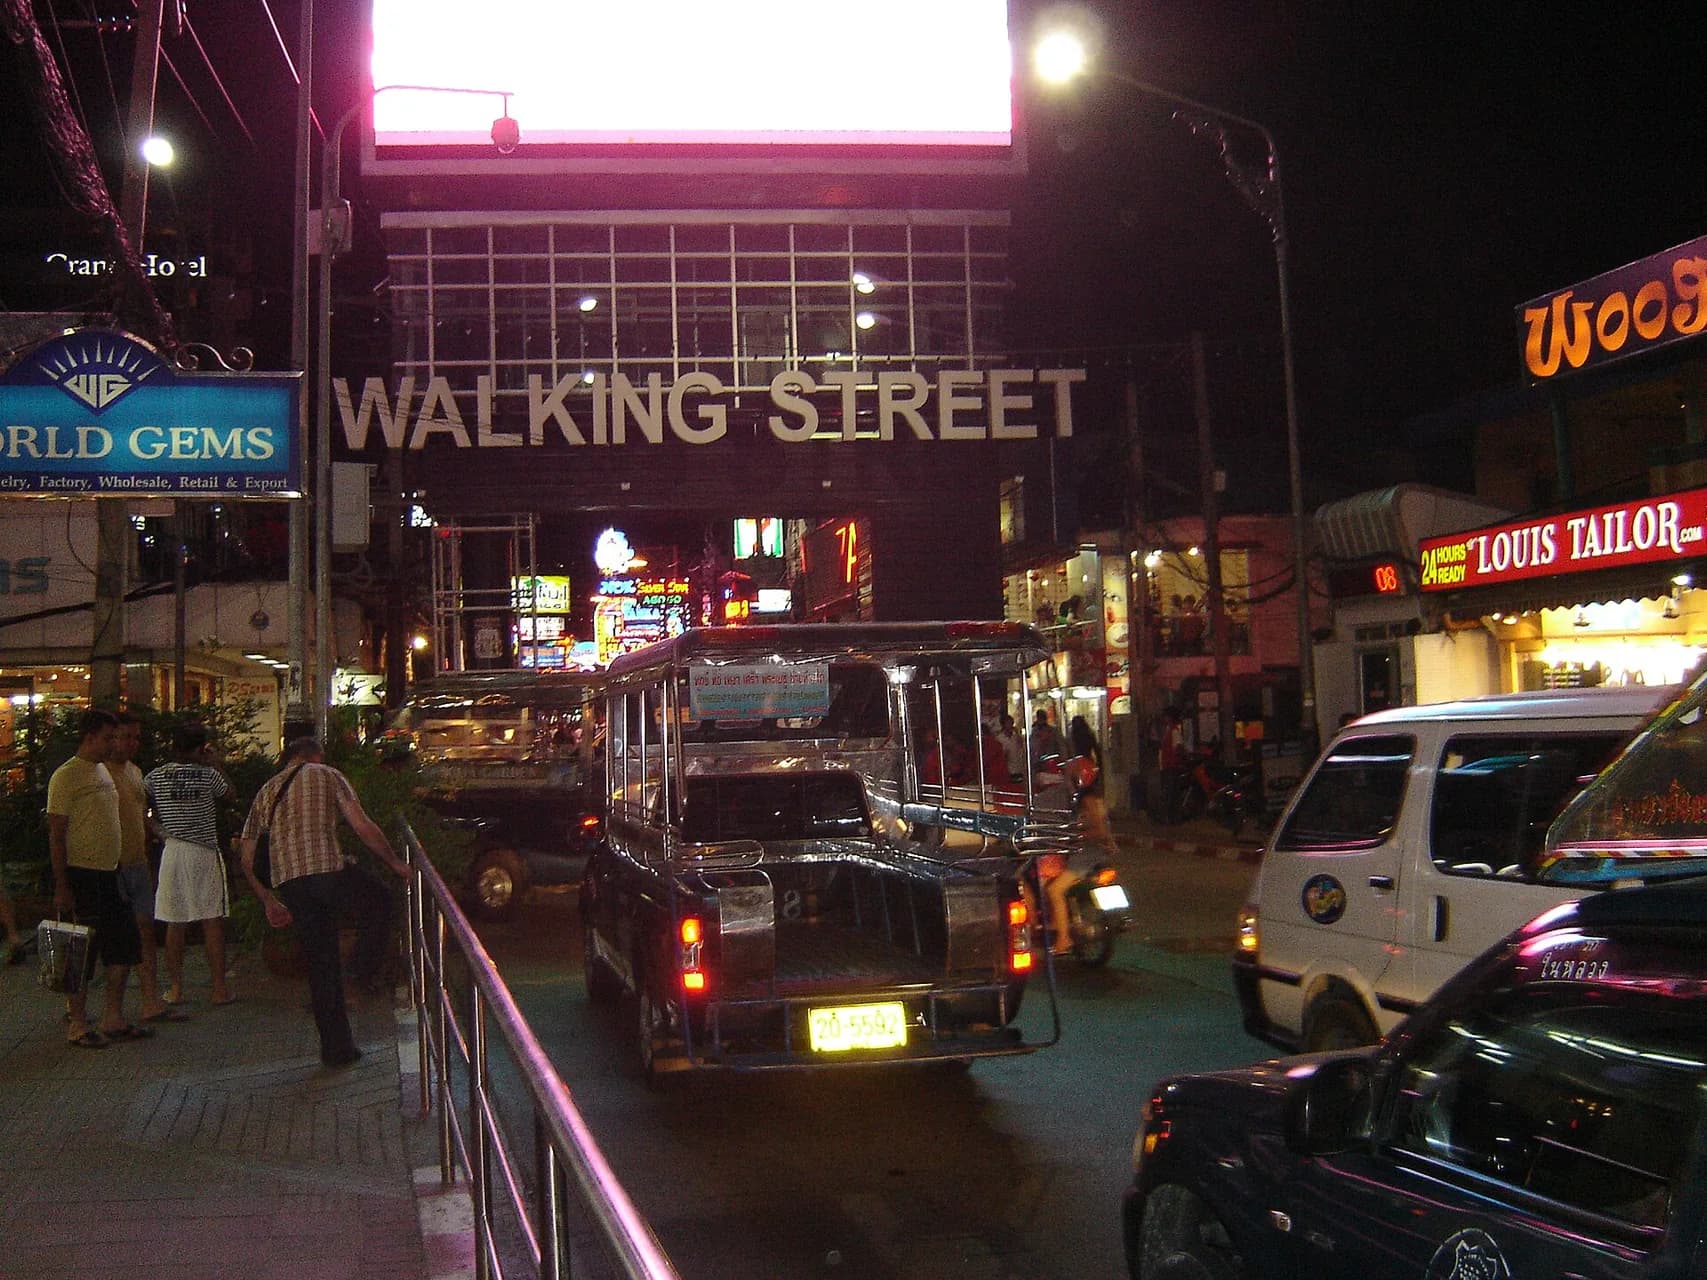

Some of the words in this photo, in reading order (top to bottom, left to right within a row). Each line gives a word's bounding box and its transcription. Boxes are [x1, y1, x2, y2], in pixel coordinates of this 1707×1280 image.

[332, 371, 729, 451] WALKING
[768, 367, 1087, 443] STREET
[0, 425, 114, 459] RLD
[128, 426, 275, 460] GEMS
[39, 475, 92, 490] Factory,
[98, 475, 172, 490] Wholesale,
[179, 476, 219, 488] Retail
[225, 476, 238, 488] &
[245, 476, 288, 490] Export
[1421, 549, 1437, 585] 24
[1437, 543, 1467, 564] HOURS
[1437, 564, 1467, 585] READY
[1540, 951, 1609, 980] ในหลวง
